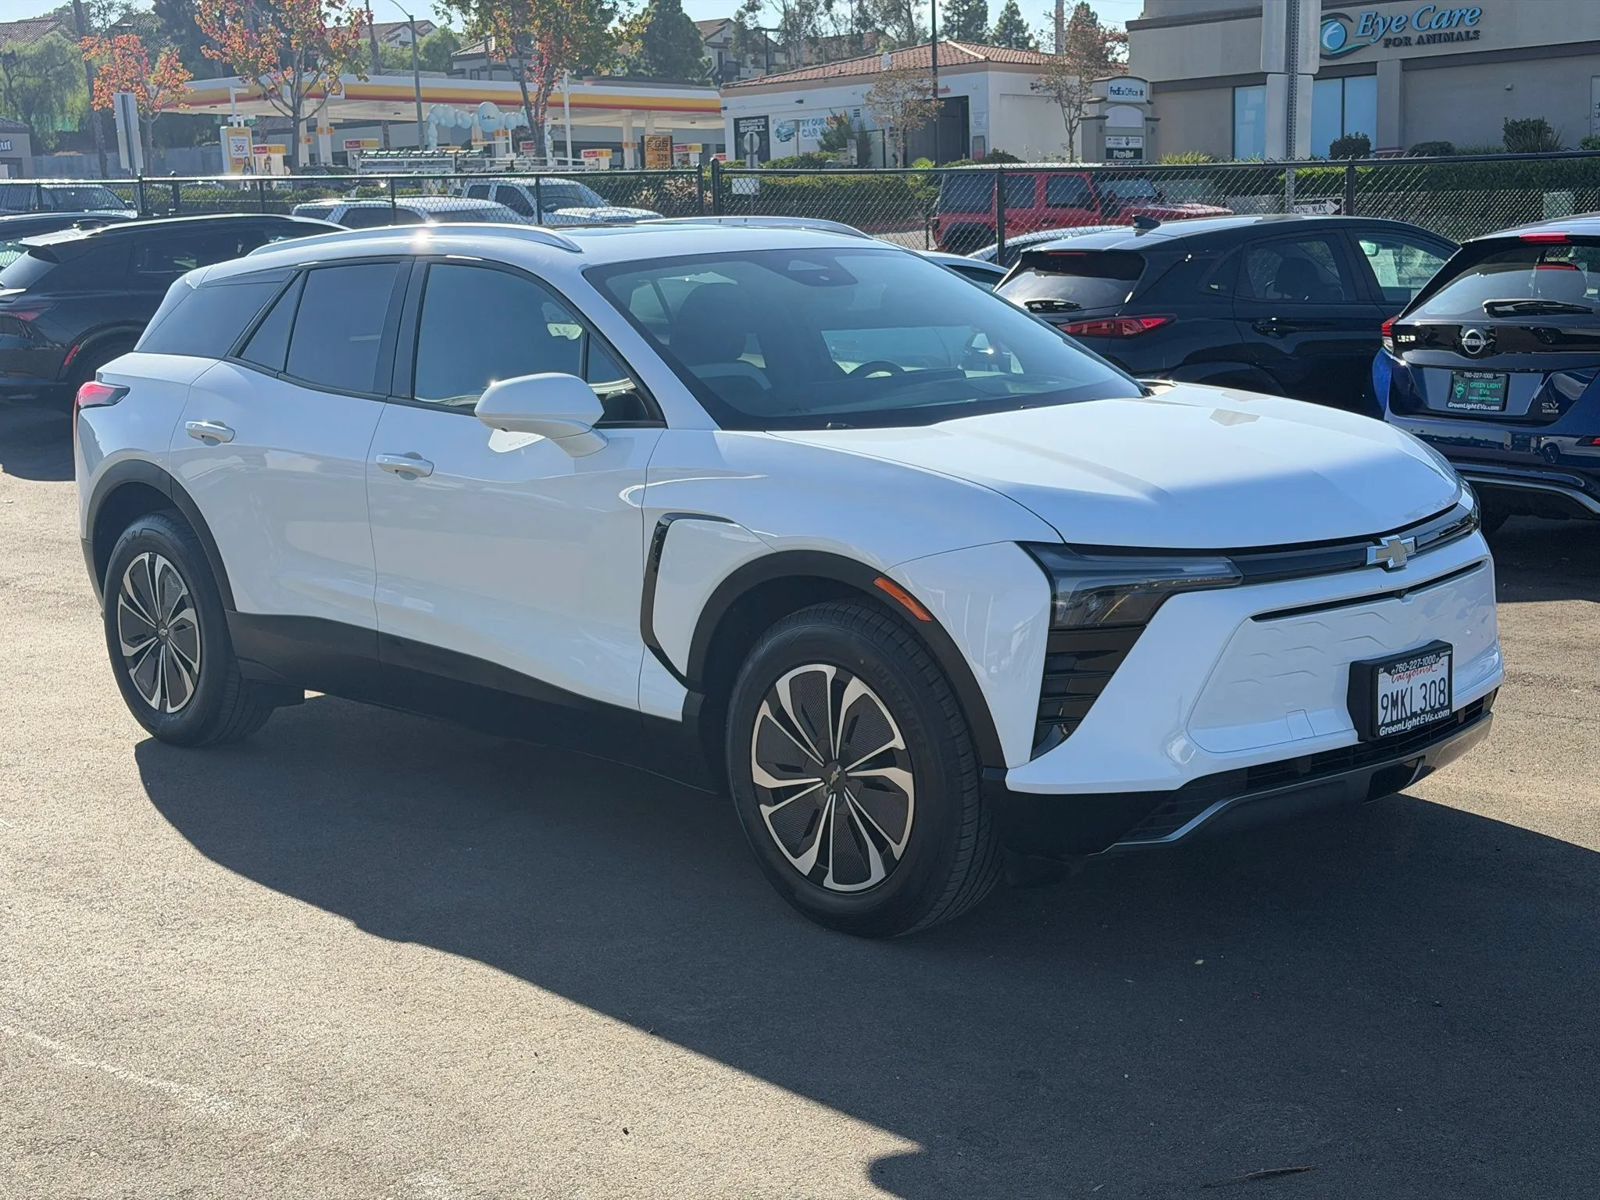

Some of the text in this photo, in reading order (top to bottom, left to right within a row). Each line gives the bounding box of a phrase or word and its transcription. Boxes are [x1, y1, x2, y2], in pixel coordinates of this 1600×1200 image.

[1355, 5, 1482, 44] Eye Care
[1383, 30, 1481, 48] FOR ANIMALS
[1396, 654, 1436, 674] 760-227-1000
